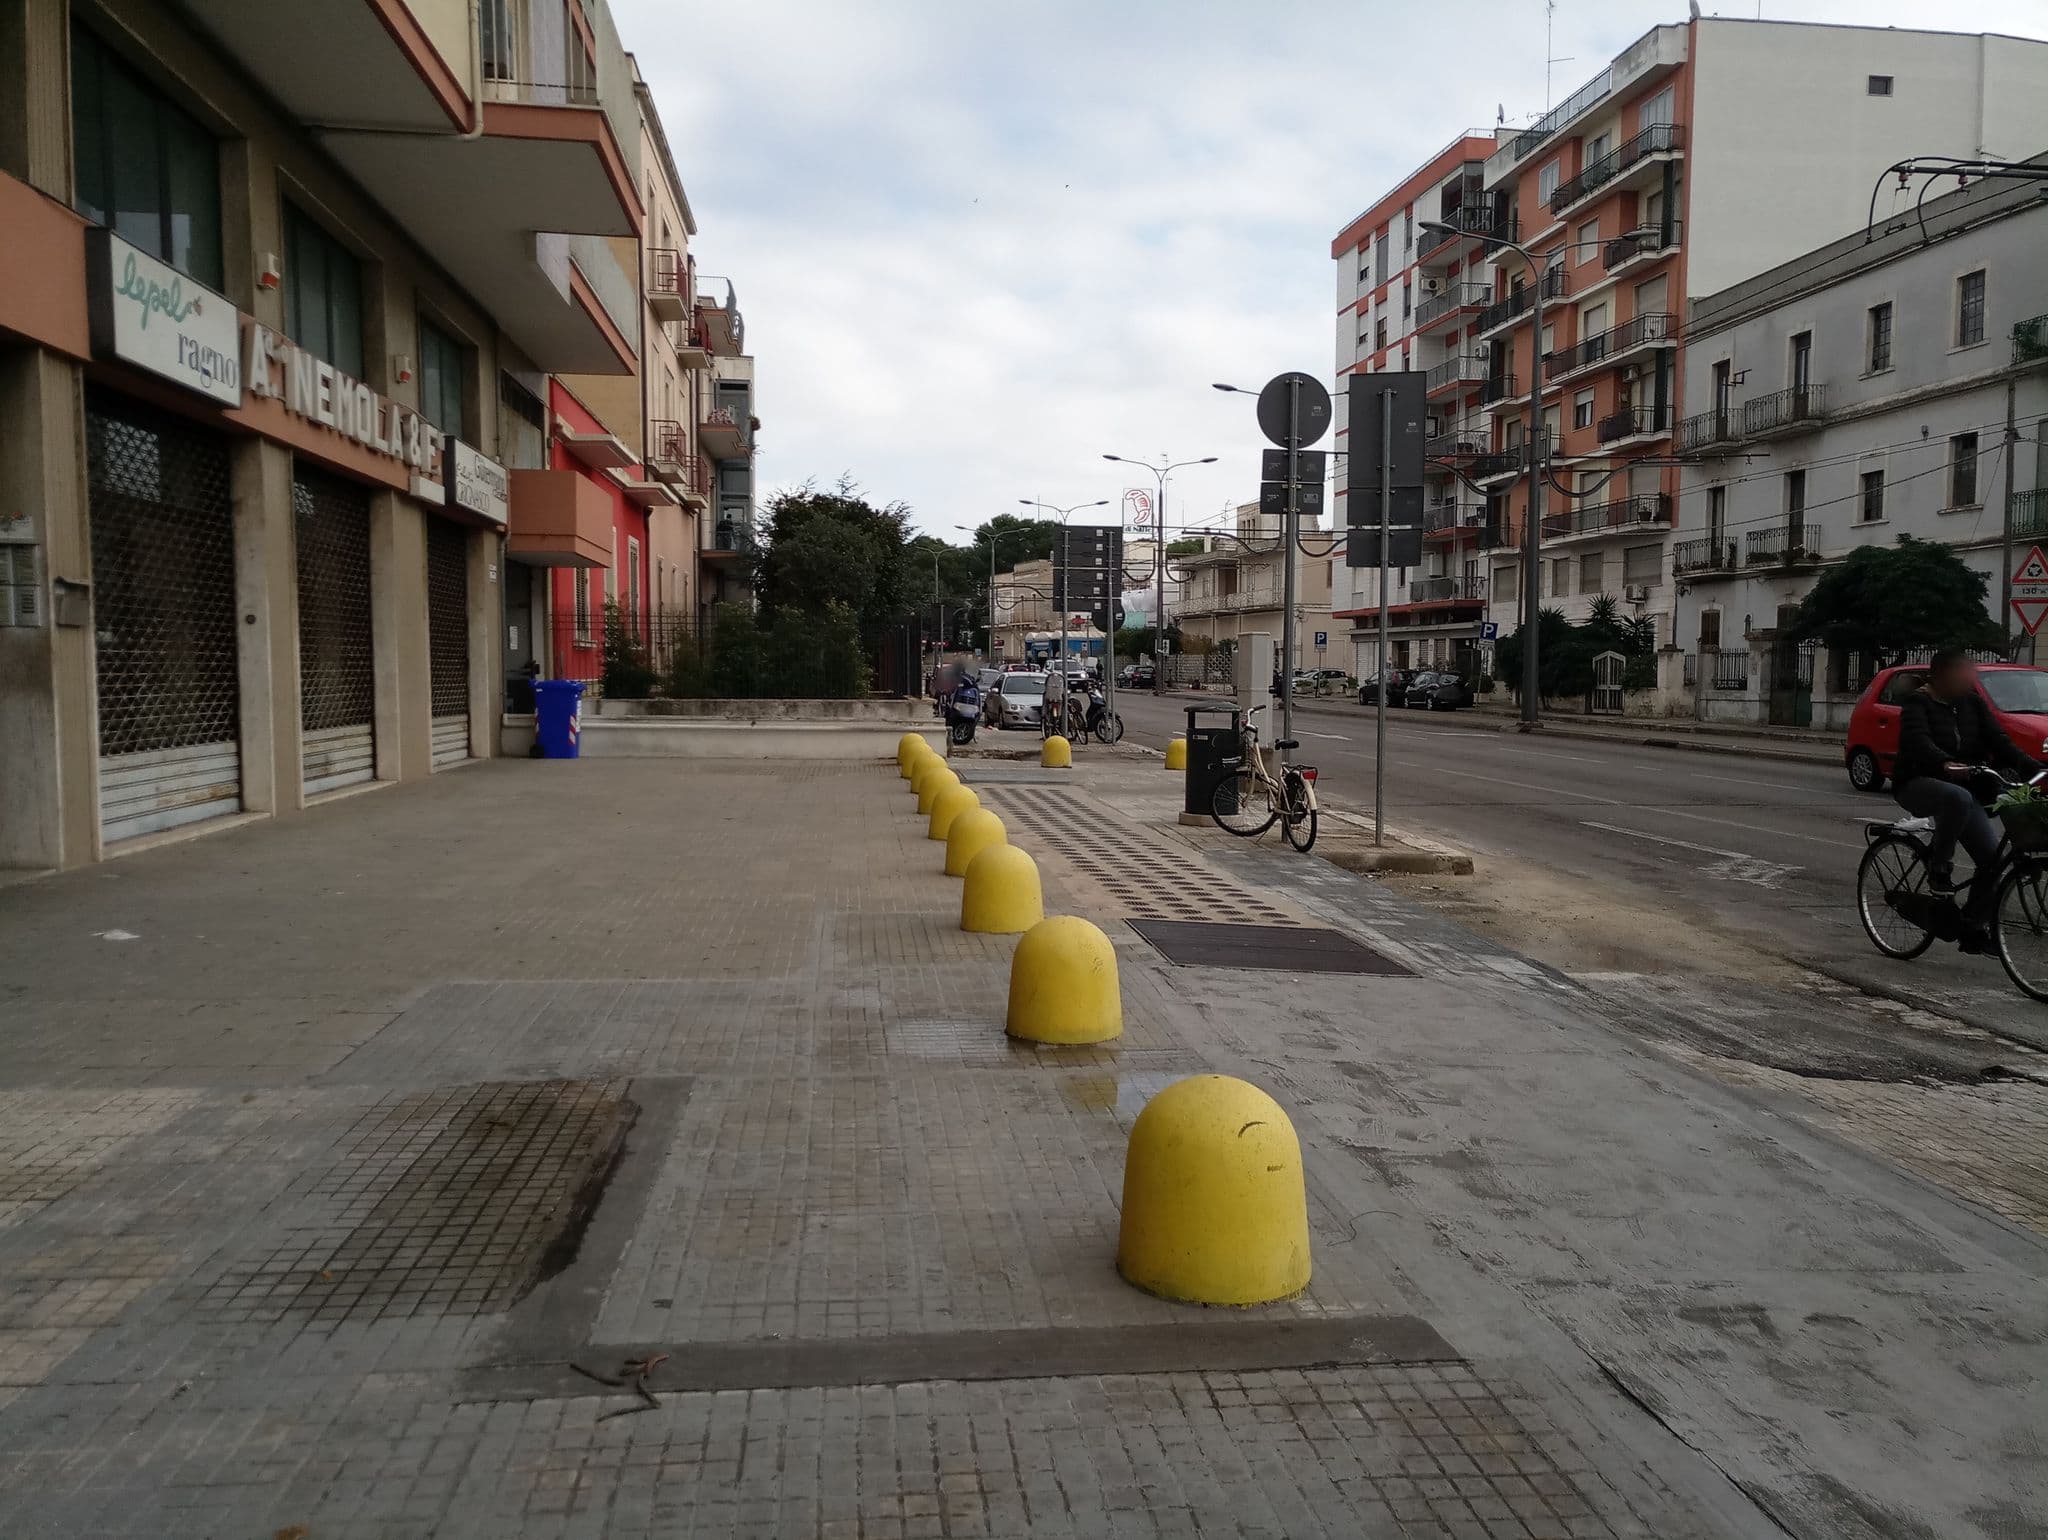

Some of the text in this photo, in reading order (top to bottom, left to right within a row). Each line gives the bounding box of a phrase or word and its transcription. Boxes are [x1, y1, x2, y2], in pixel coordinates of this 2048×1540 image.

[177, 333, 238, 388] ragno
[1317, 632, 1326, 644] P
[1483, 624, 1495, 638] P
